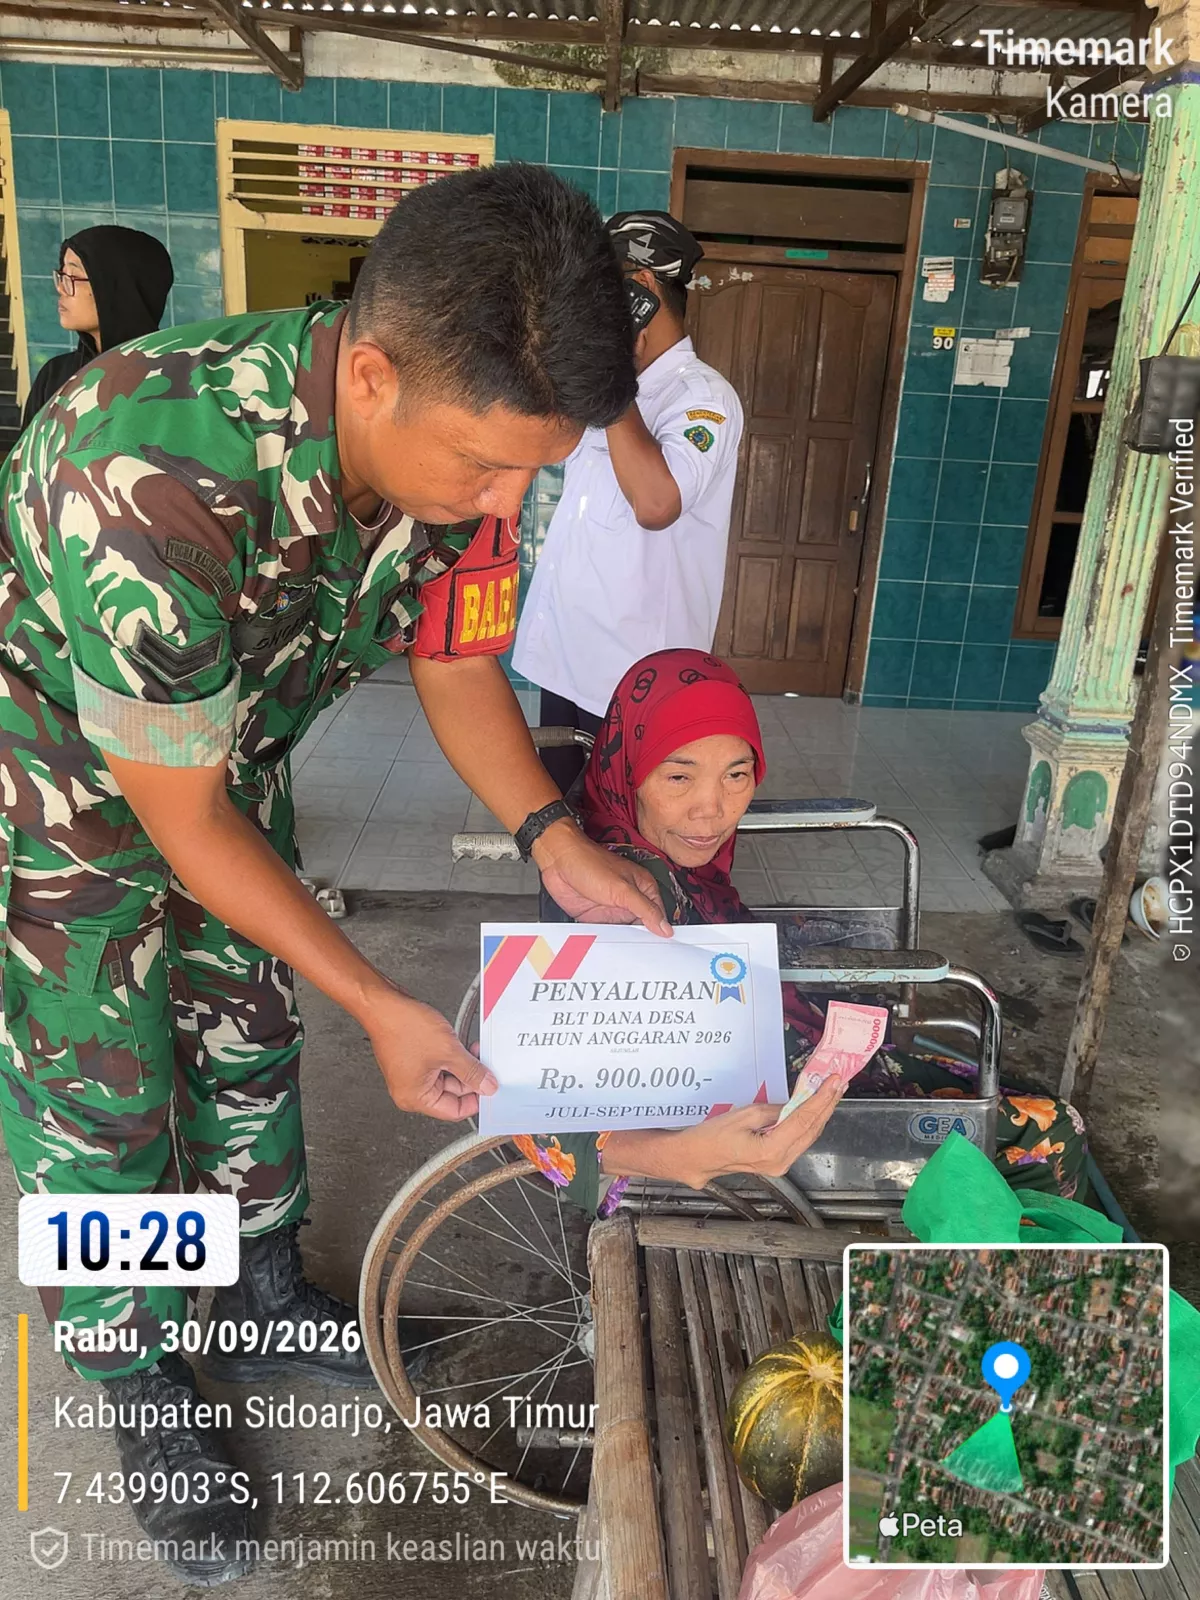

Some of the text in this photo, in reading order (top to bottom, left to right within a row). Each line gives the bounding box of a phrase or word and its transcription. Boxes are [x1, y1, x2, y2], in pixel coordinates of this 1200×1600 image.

[932, 336, 954, 350] 90
[530, 980, 717, 1003] PENYALURAN
[551, 1009, 696, 1027] BLT DANA DESA
[517, 1030, 732, 1047] TAHUN ANGGARAN 2026
[864, 1018, 882, 1053] 100000
[538, 1066, 713, 1093] Rp. 900.000,-
[544, 1103, 709, 1120] JULI-SEPTEMBER
[918, 1116, 967, 1136] GEA
